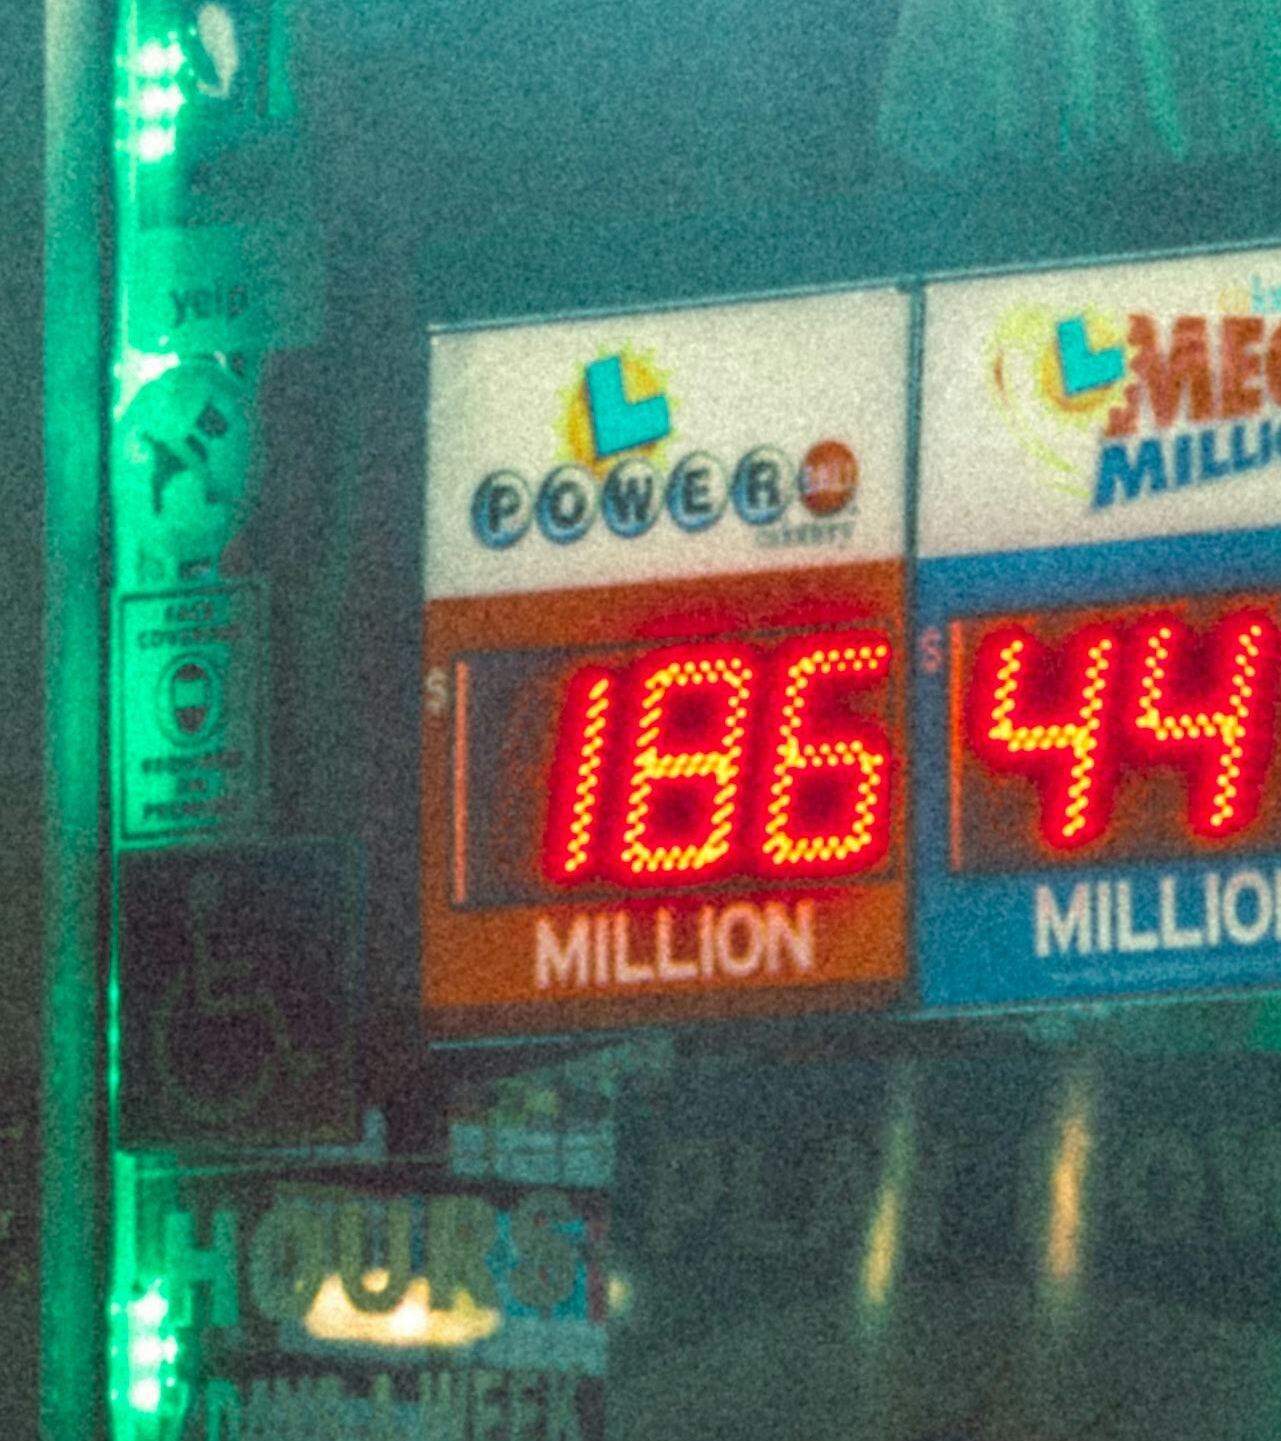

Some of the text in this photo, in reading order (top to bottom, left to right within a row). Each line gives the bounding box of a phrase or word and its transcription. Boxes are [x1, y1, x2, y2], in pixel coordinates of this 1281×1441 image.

[558, 635, 890, 881] 186
[534, 899, 817, 989] MILLION
[166, 1194, 579, 1327] HOURS
